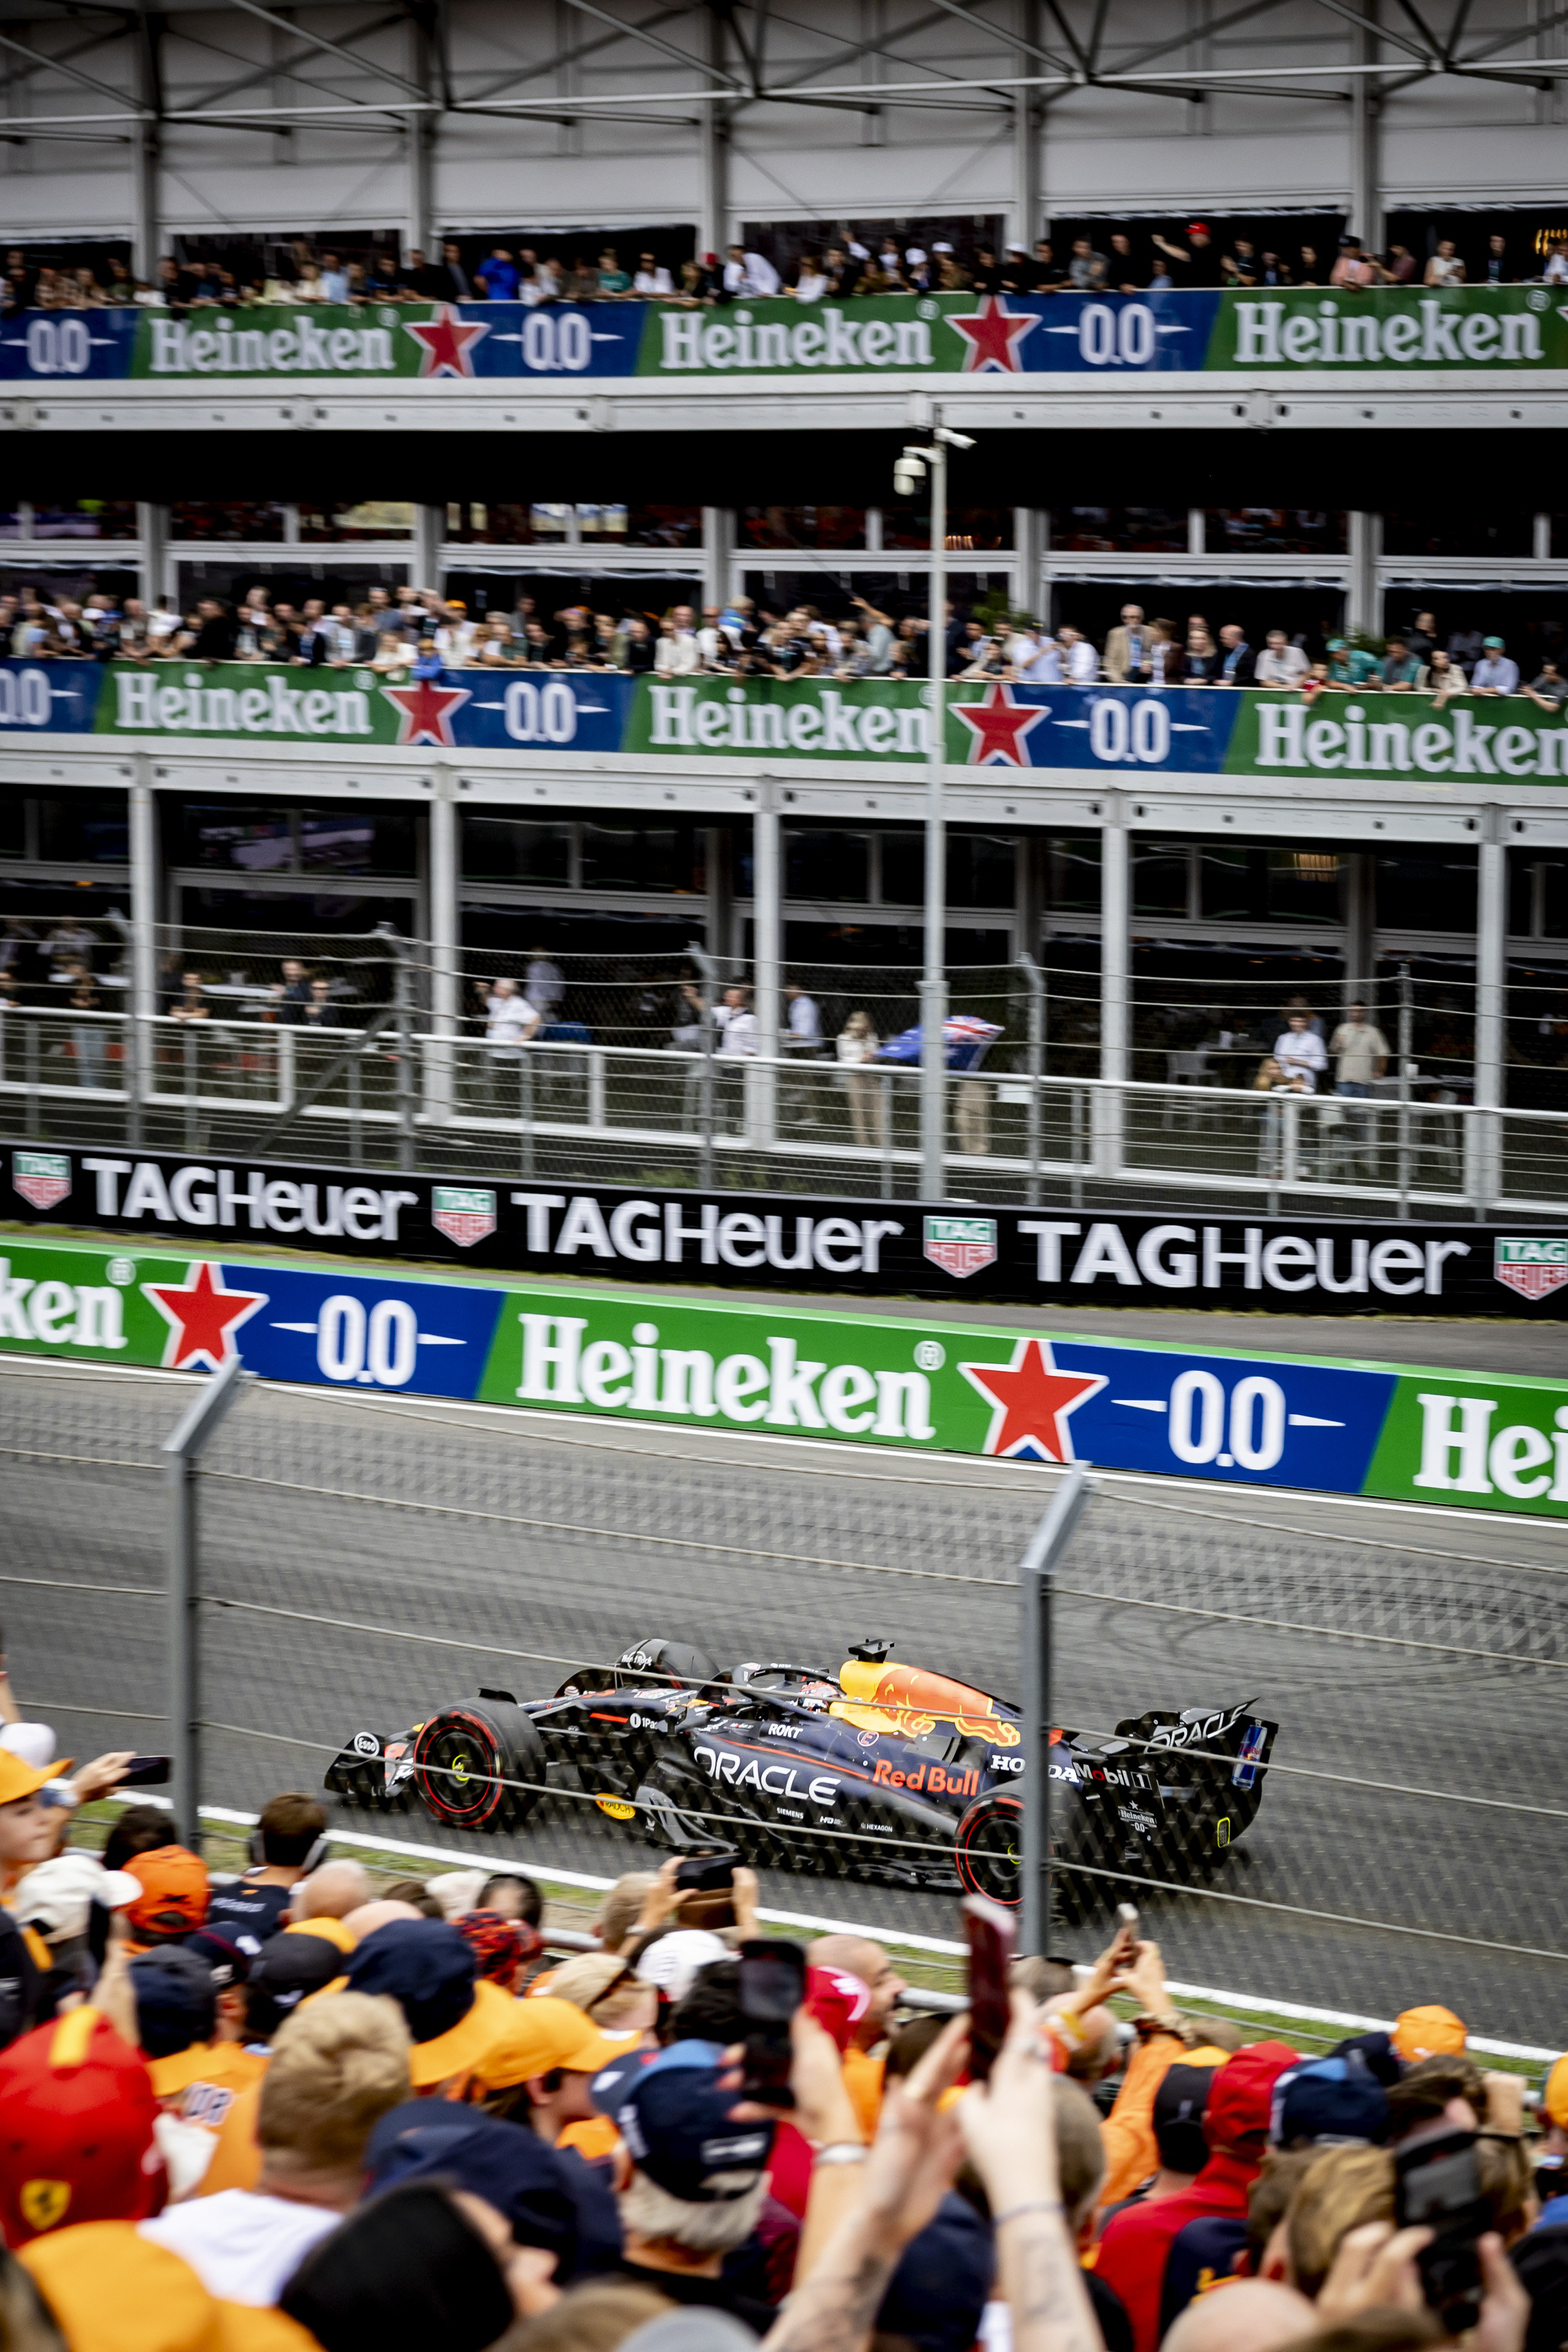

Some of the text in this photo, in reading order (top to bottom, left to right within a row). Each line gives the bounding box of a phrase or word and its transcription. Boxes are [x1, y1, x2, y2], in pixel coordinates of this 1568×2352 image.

[149, 316, 397, 372] Heineken
[521, 312, 591, 371] 0.0
[659, 308, 935, 370] Heineken
[1078, 303, 1155, 365] 0.0
[1232, 299, 1545, 363] Heineken
[113, 671, 374, 736] Heineken
[504, 681, 578, 743] 0.0
[648, 684, 935, 754] Heineken
[1089, 697, 1171, 764] 0.0
[437, 1191, 490, 1211] TAG
[929, 1220, 991, 1241] TAG
[1500, 1241, 1568, 1262] TAG
[317, 1295, 417, 1386] 0.0
[516, 1312, 937, 1441] Heineken
[1168, 1370, 1286, 1471] 0.0
[358, 1737, 376, 1752] Esso
[768, 1723, 803, 1739] ROKT
[694, 1746, 841, 1806] ORACLE
[990, 1755, 1080, 1783] HODA
[1072, 1762, 1130, 1786] Mobil
[777, 1807, 804, 1820] SIEMENS
[867, 1823, 893, 1833] HEXAGON
[1120, 1809, 1155, 1825] Heineken
